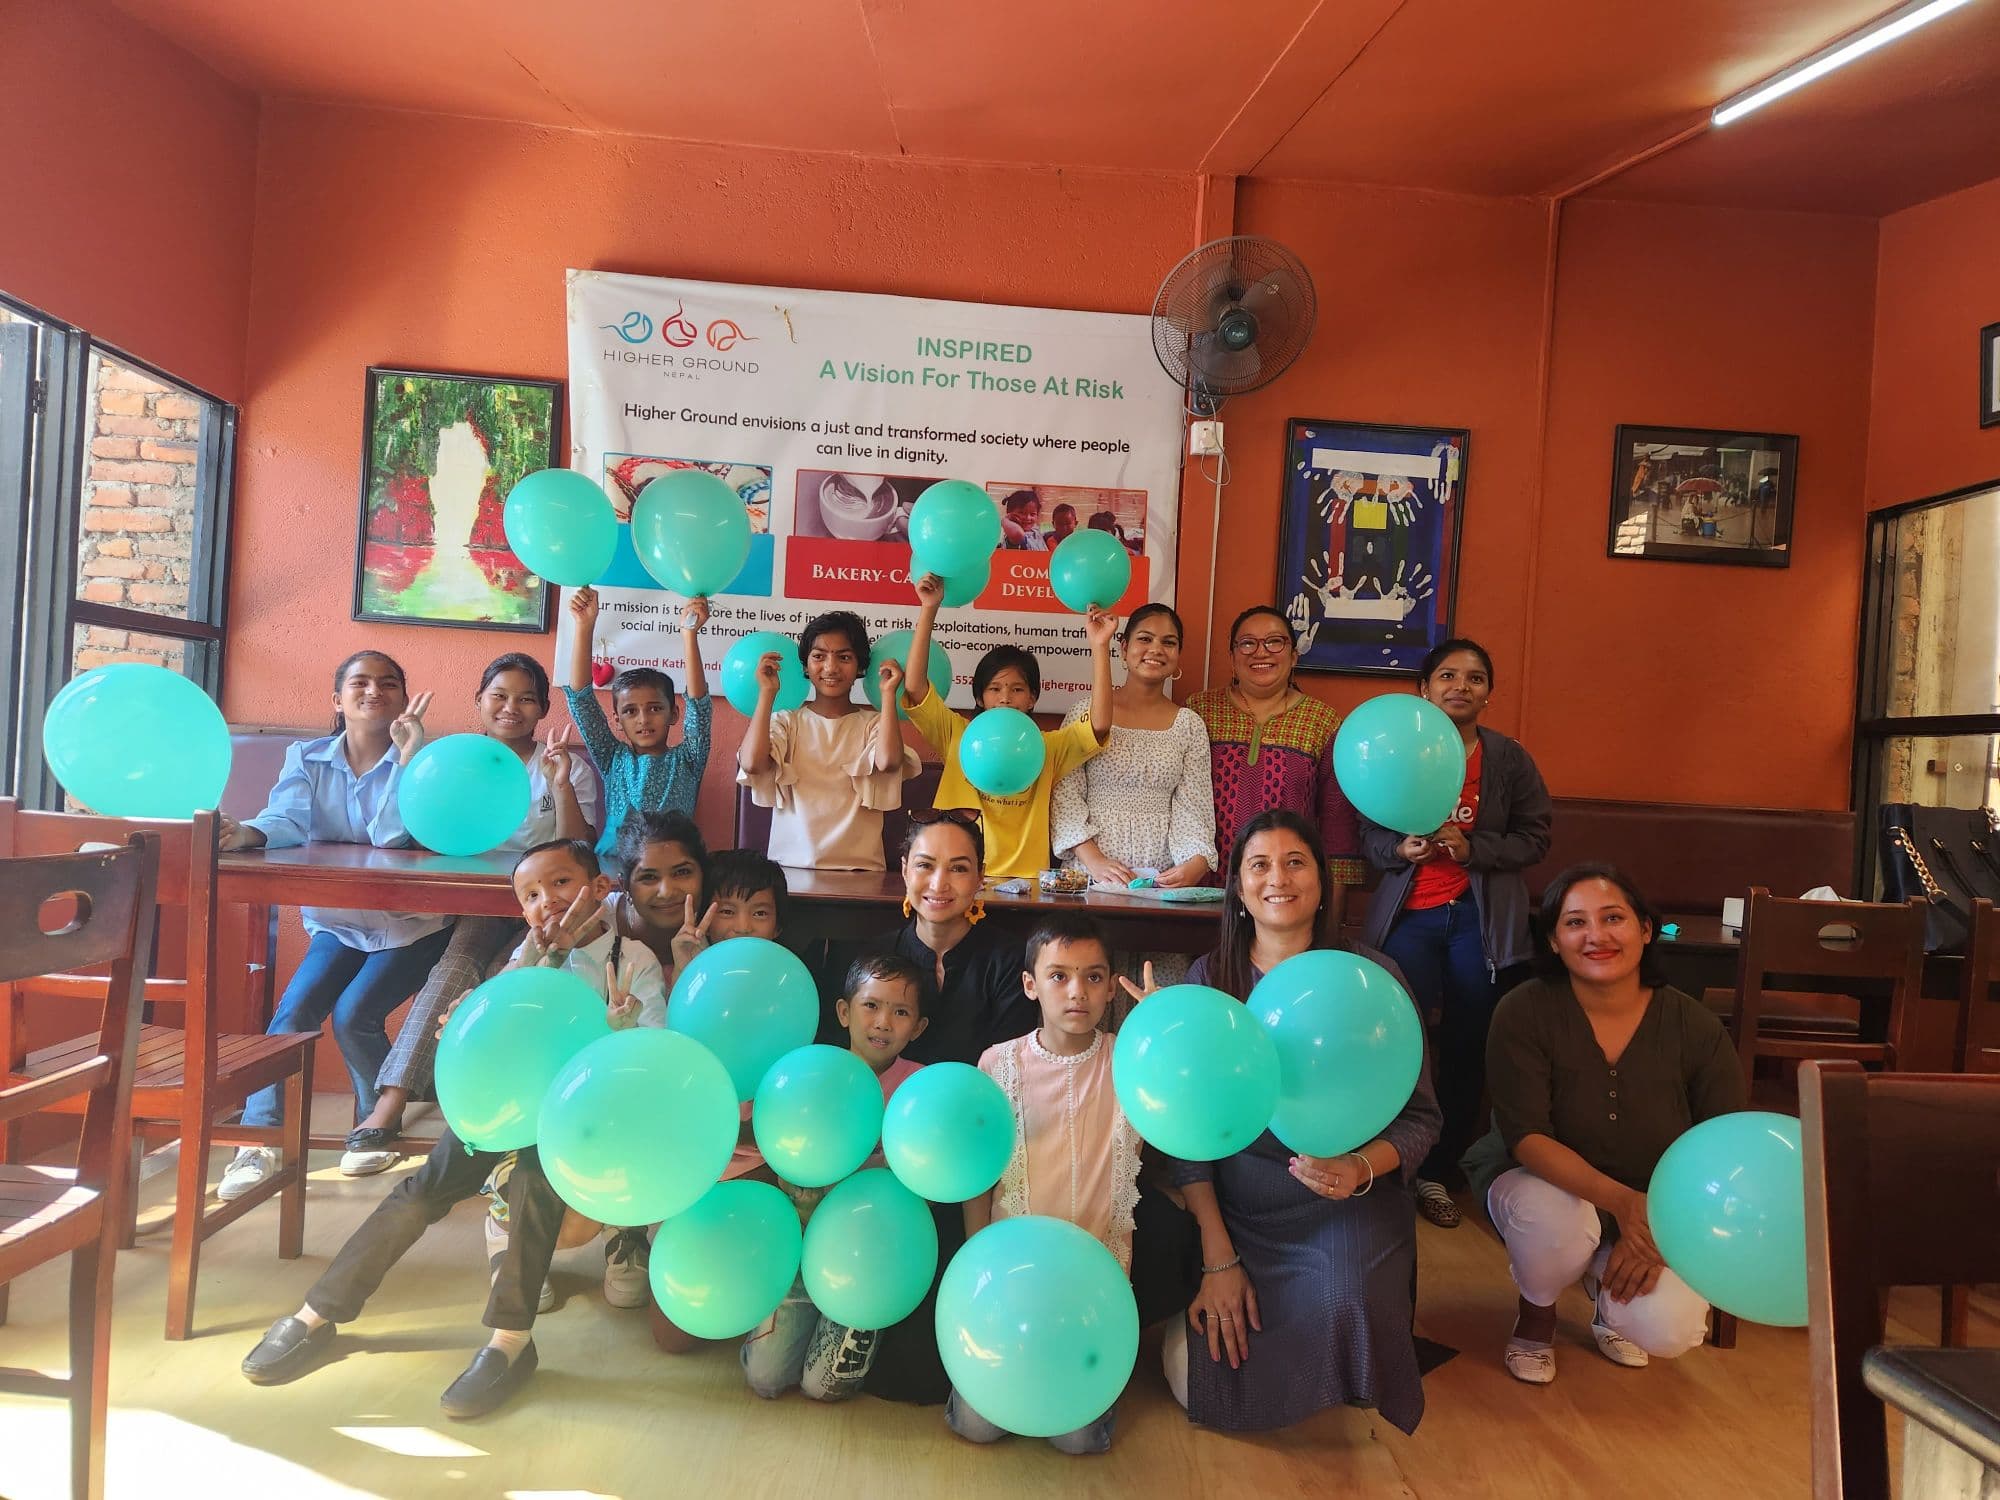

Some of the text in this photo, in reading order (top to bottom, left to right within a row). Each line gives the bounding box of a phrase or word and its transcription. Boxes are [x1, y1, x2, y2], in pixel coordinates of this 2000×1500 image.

[917, 336, 1032, 363] INSPIRED
[603, 350, 760, 374] HIGHER GROUND
[663, 371, 701, 381] NEPAL
[819, 360, 1124, 399] A Vision For Those At Risk
[624, 403, 1130, 455] Higher Ground envisions a just and transformed society where people
[816, 443, 948, 465] can live in dignity.
[812, 564, 912, 584] BAKERY-CA
[598, 601, 610, 611] ur
[614, 602, 659, 614] mission
[662, 603, 670, 615] is
[736, 608, 757, 620] the
[760, 609, 786, 623] lives
[789, 611, 802, 623] of
[874, 617, 888, 628] at
[891, 617, 912, 630] risk
[1014, 624, 1058, 638] human
[621, 620, 654, 632] social
[617, 655, 659, 667] Ground
